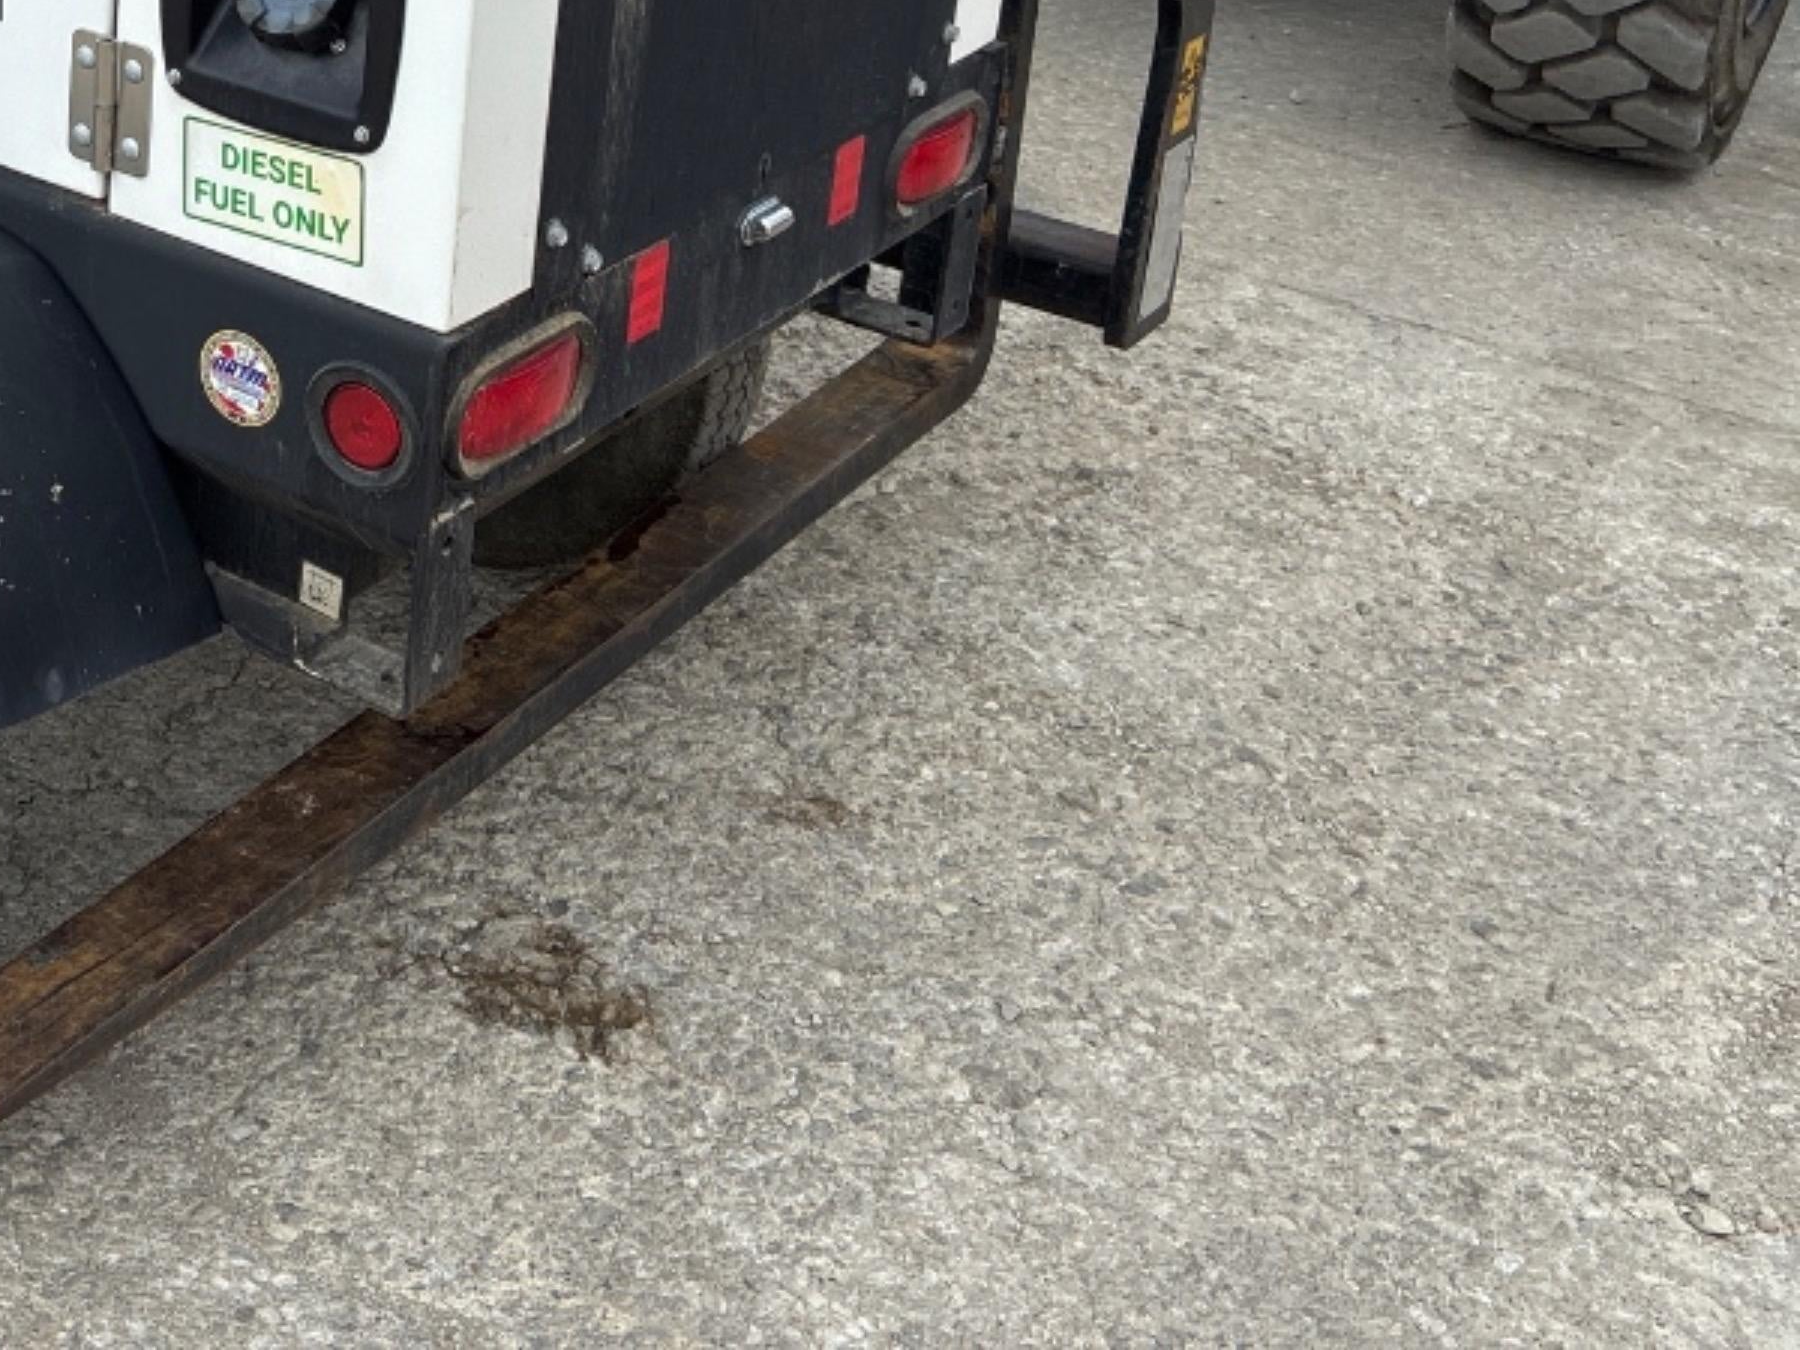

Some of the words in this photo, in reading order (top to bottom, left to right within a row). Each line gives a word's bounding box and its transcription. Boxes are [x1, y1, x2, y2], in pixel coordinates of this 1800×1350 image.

[219, 141, 323, 196] DIESEL
[193, 176, 265, 222] FUEL
[272, 199, 351, 246] ONLY
